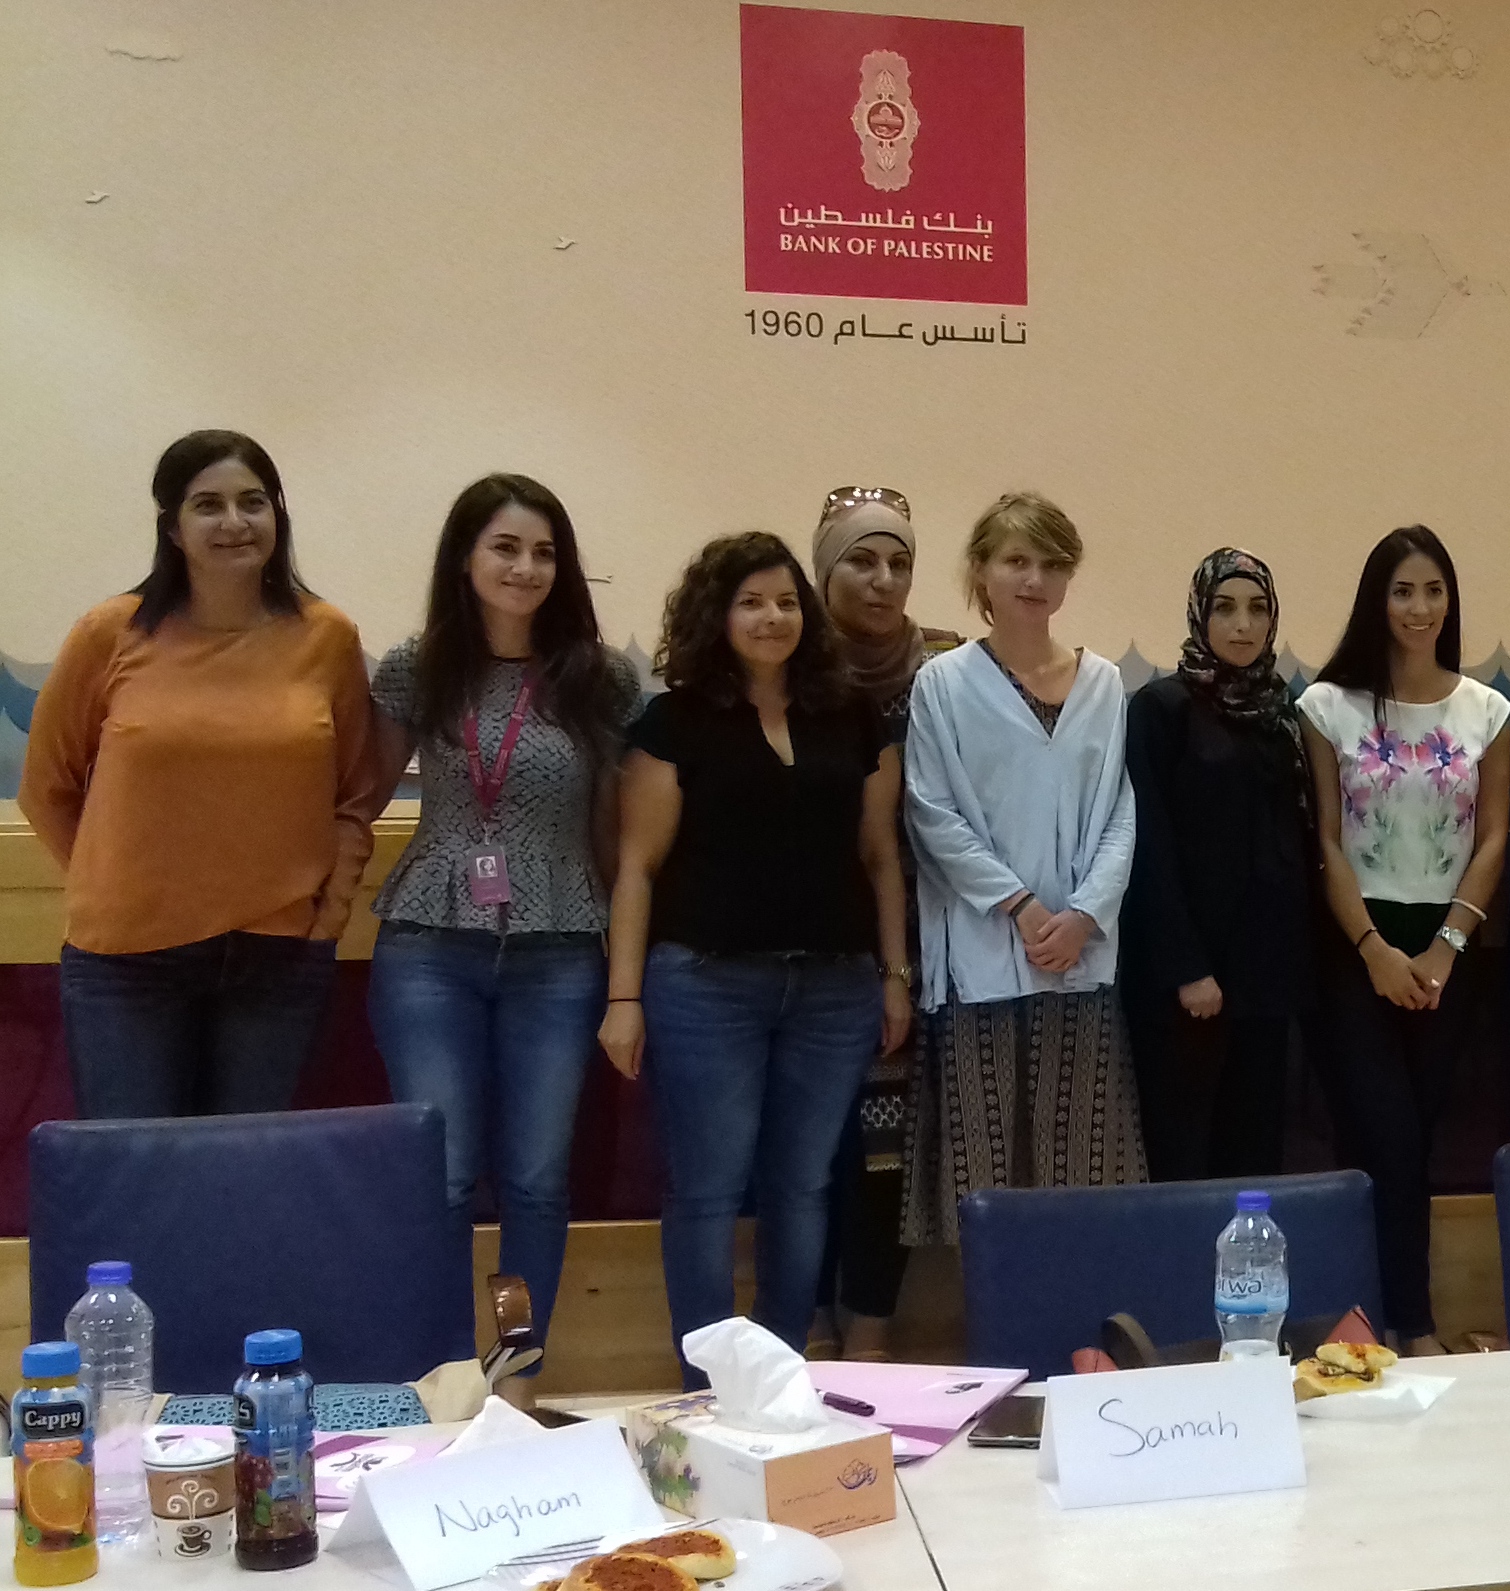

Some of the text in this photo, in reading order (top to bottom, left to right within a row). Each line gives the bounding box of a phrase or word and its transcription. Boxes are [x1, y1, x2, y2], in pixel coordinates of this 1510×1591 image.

[779, 202, 993, 239] بنك فلسطين
[780, 233, 994, 262] BANK OF PALESTINE
[744, 309, 1027, 346] تأسس عام 1960
[1217, 1278, 1262, 1294] rwa
[25, 1410, 82, 1431] Cappy
[1098, 1398, 1238, 1457] Samah
[434, 1492, 582, 1537] Nagham
